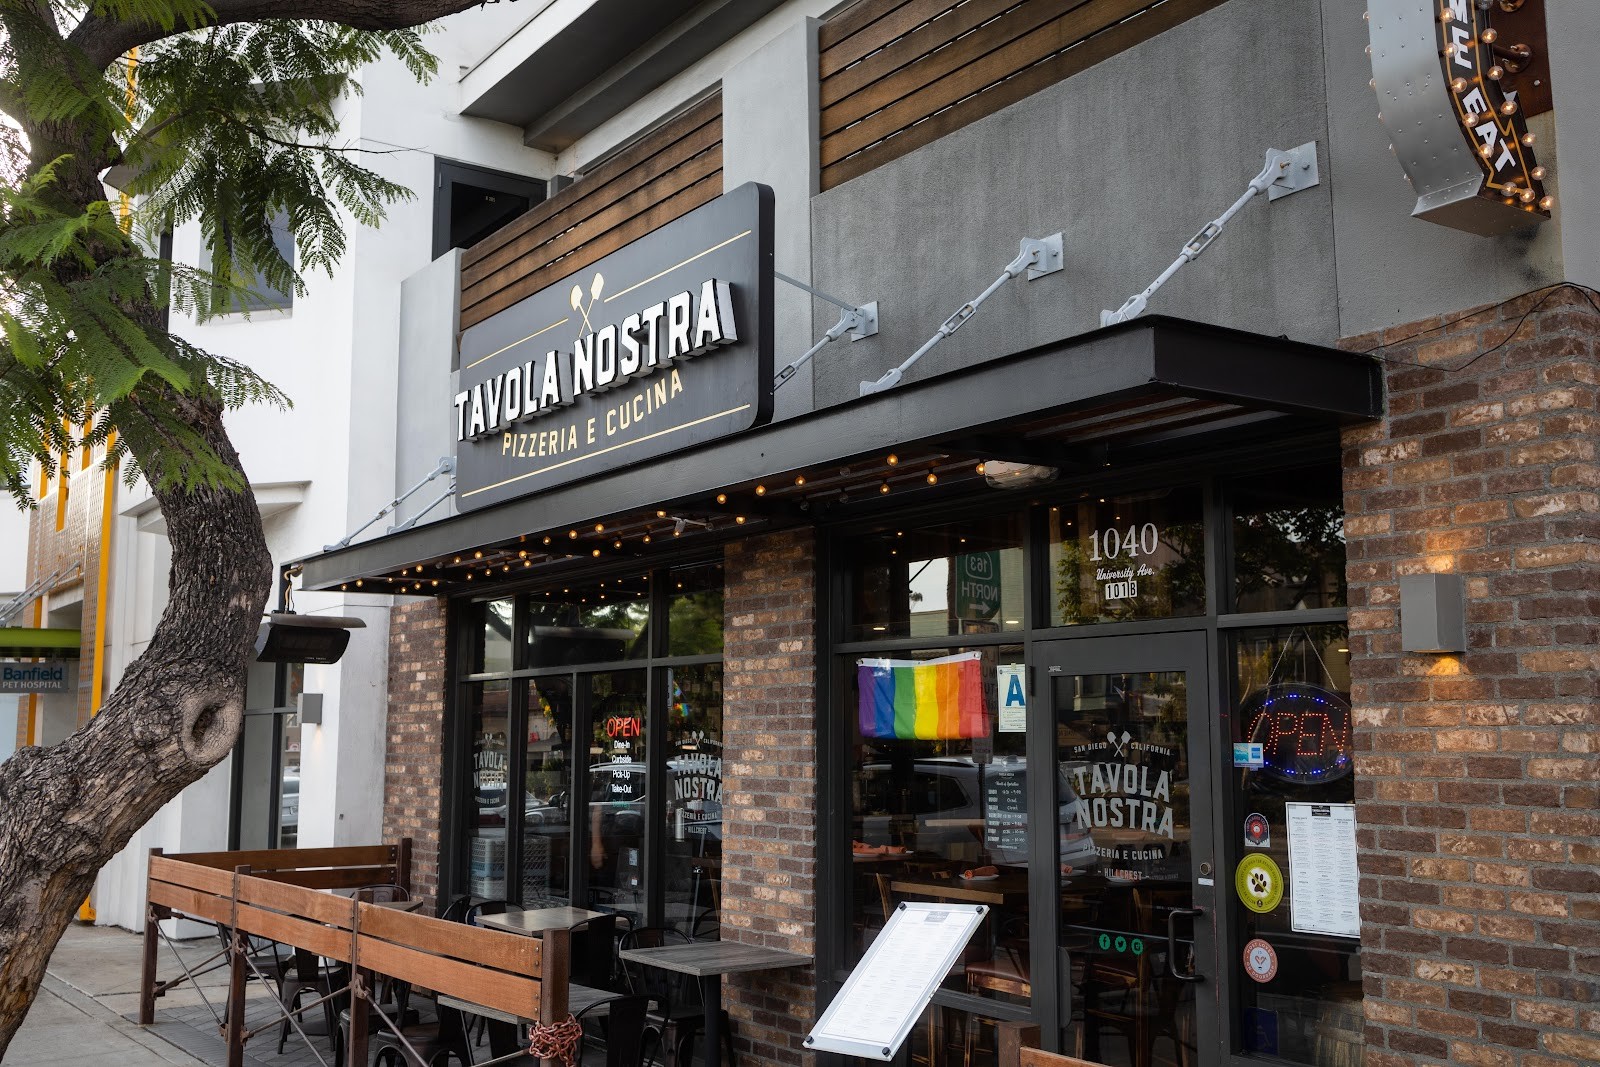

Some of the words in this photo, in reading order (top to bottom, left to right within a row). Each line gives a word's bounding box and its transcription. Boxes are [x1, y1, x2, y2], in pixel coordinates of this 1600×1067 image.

[1462, 87, 1516, 172] EAT
[455, 350, 564, 442] TAVOLA
[573, 278, 728, 398] NOSTRA
[502, 424, 578, 458] PIZZERIA
[587, 417, 597, 444] E
[606, 368, 684, 436] CUCINA
[1088, 522, 1159, 562] 1040
[1096, 566, 1135, 582] University
[1137, 563, 1155, 577] Ave.
[3, 667, 63, 680] Banfield
[2, 681, 19, 689] PET
[20, 681, 62, 689] HOSPITAL
[1006, 675, 1026, 706] A
[606, 717, 640, 737] OPEN
[1247, 712, 1349, 756] OPEN
[613, 740, 631, 749] Dine-In
[473, 751, 504, 770] TAVOLA
[611, 755, 632, 764] Curbside
[675, 753, 722, 779] TAVOLA
[612, 770, 631, 780] Pick-Up
[1073, 763, 1170, 803] TAVOLA
[611, 784, 632, 793] Take-Out
[675, 777, 722, 804] NOSTRA
[1075, 797, 1174, 839] NOSTRA
[1082, 843, 1120, 859] PIZZERIA
[1122, 850, 1129, 860] E
[1131, 848, 1164, 860] CUCINA
[1104, 868, 1143, 881] HILLCREST
